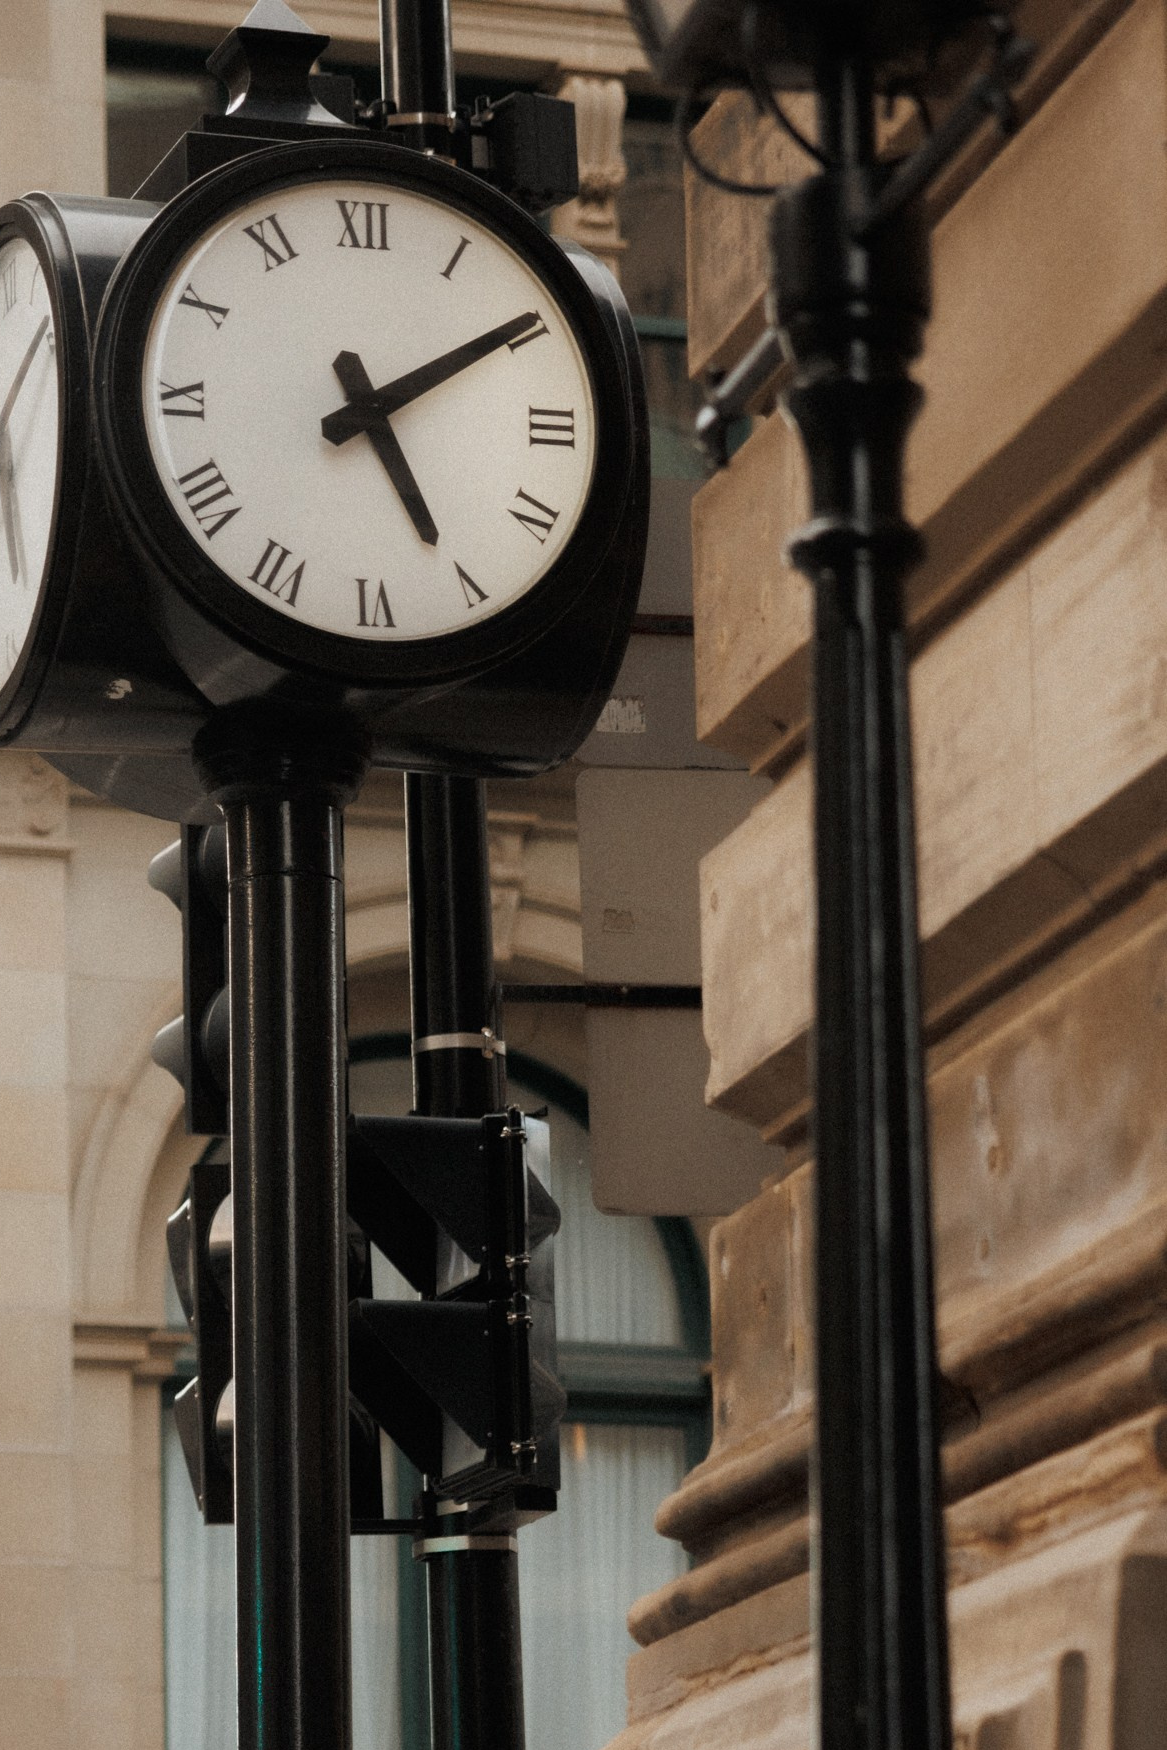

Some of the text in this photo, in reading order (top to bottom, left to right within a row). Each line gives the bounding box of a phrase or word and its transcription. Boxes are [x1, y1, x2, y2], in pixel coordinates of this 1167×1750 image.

[242, 213, 300, 271] XI
[336, 200, 391, 250] XII
[440, 236, 472, 280] I
[179, 284, 230, 329] X
[159, 381, 205, 421] IX
[528, 404, 575, 450] III
[178, 458, 242, 540] VIII
[507, 488, 560, 544] IV
[247, 538, 306, 608] VII
[453, 560, 490, 609] V
[355, 578, 396, 628] VI
